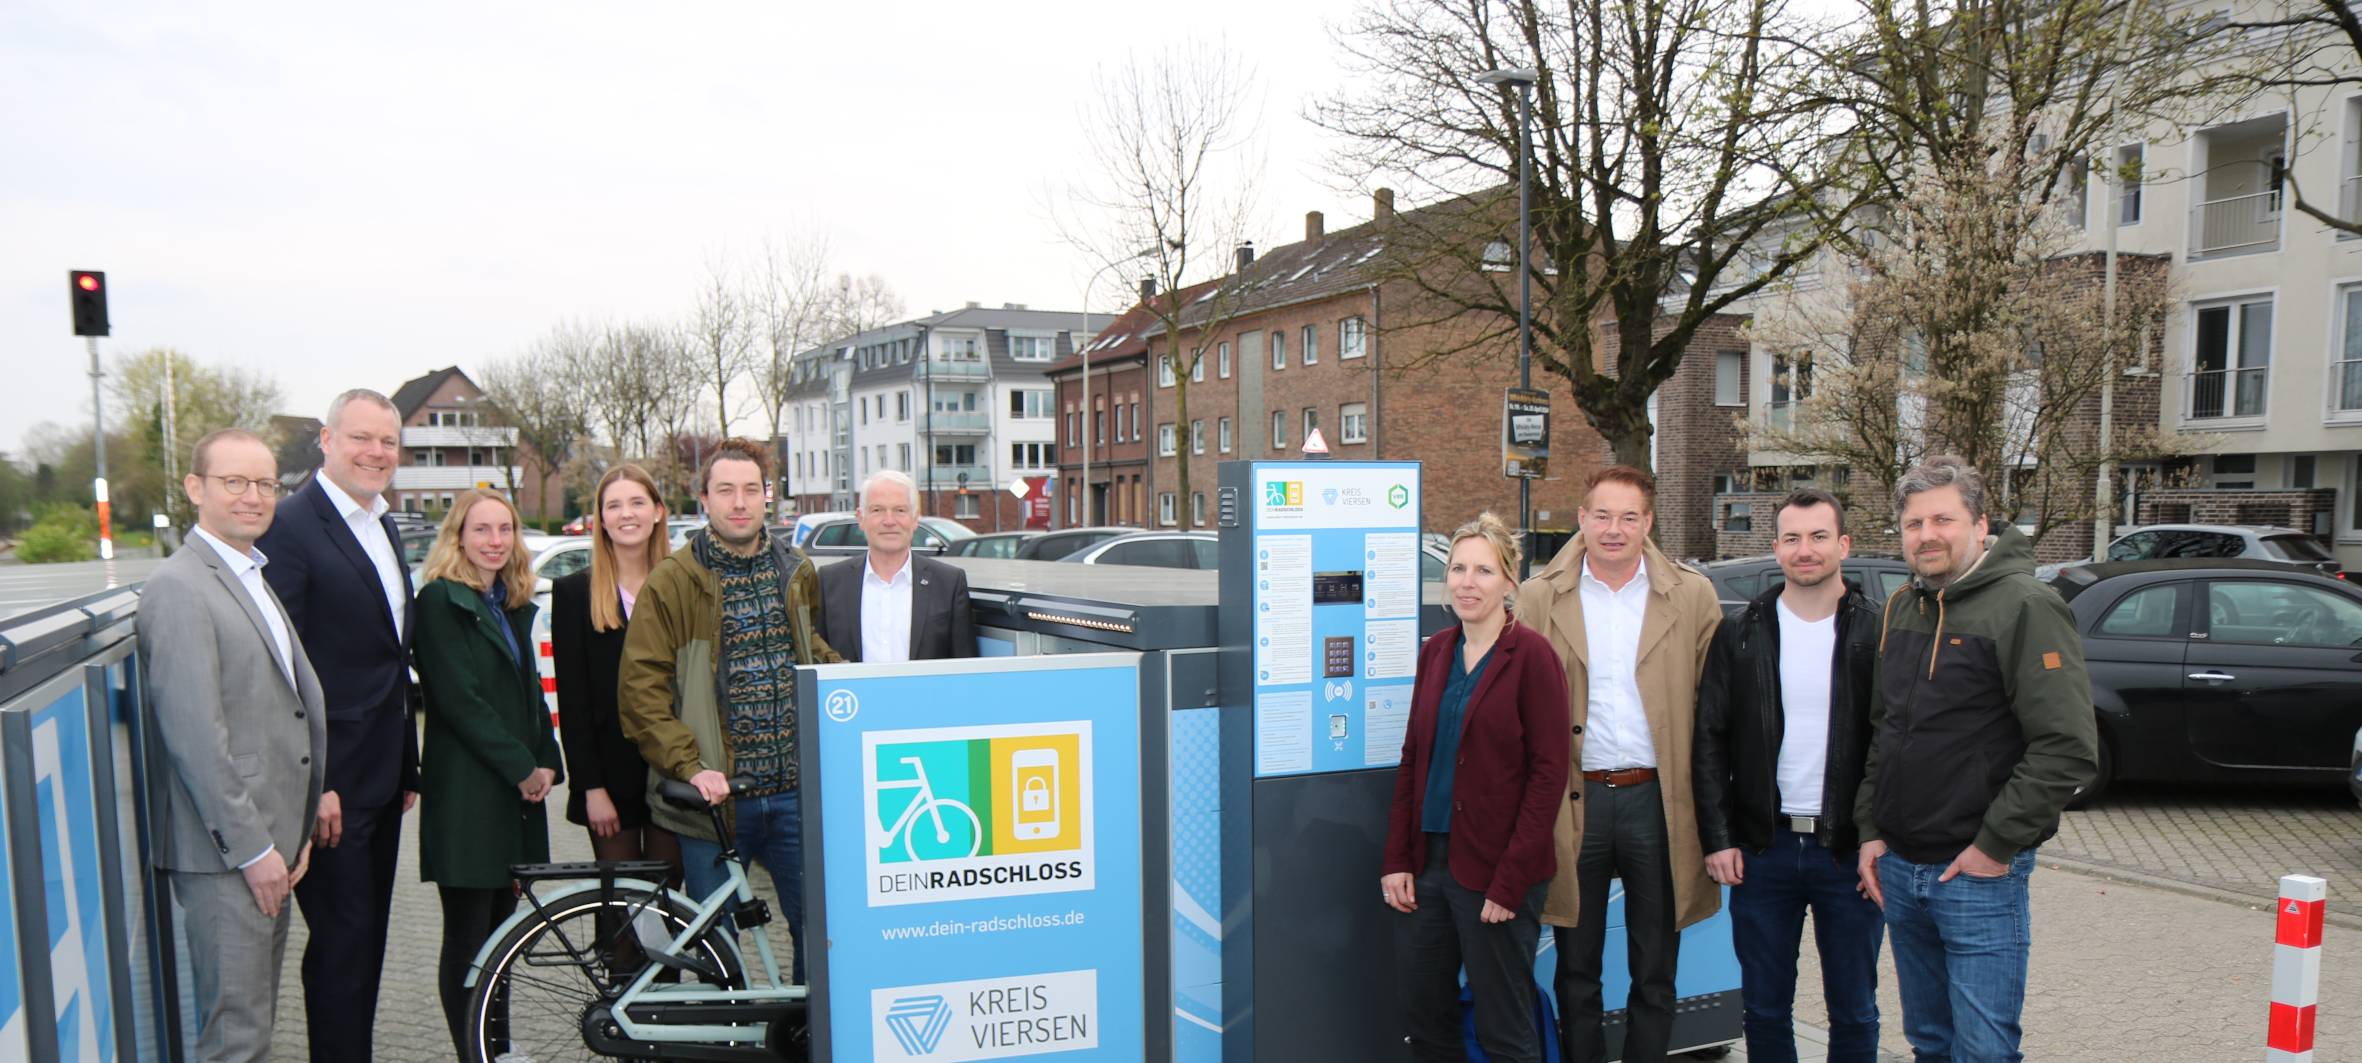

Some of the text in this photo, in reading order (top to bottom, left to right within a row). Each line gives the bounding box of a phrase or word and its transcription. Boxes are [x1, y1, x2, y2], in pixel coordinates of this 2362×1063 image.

[1341, 488, 1362, 496] KREIS
[1342, 498, 1371, 506] VIERSEN
[832, 696, 853, 715] 21
[879, 861, 1083, 894] DEINRADSCHLOSS
[881, 910, 1085, 941] www.dein-radschloss.de
[969, 985, 1048, 1017] KREIS
[971, 1014, 1087, 1050] VIERSEN
